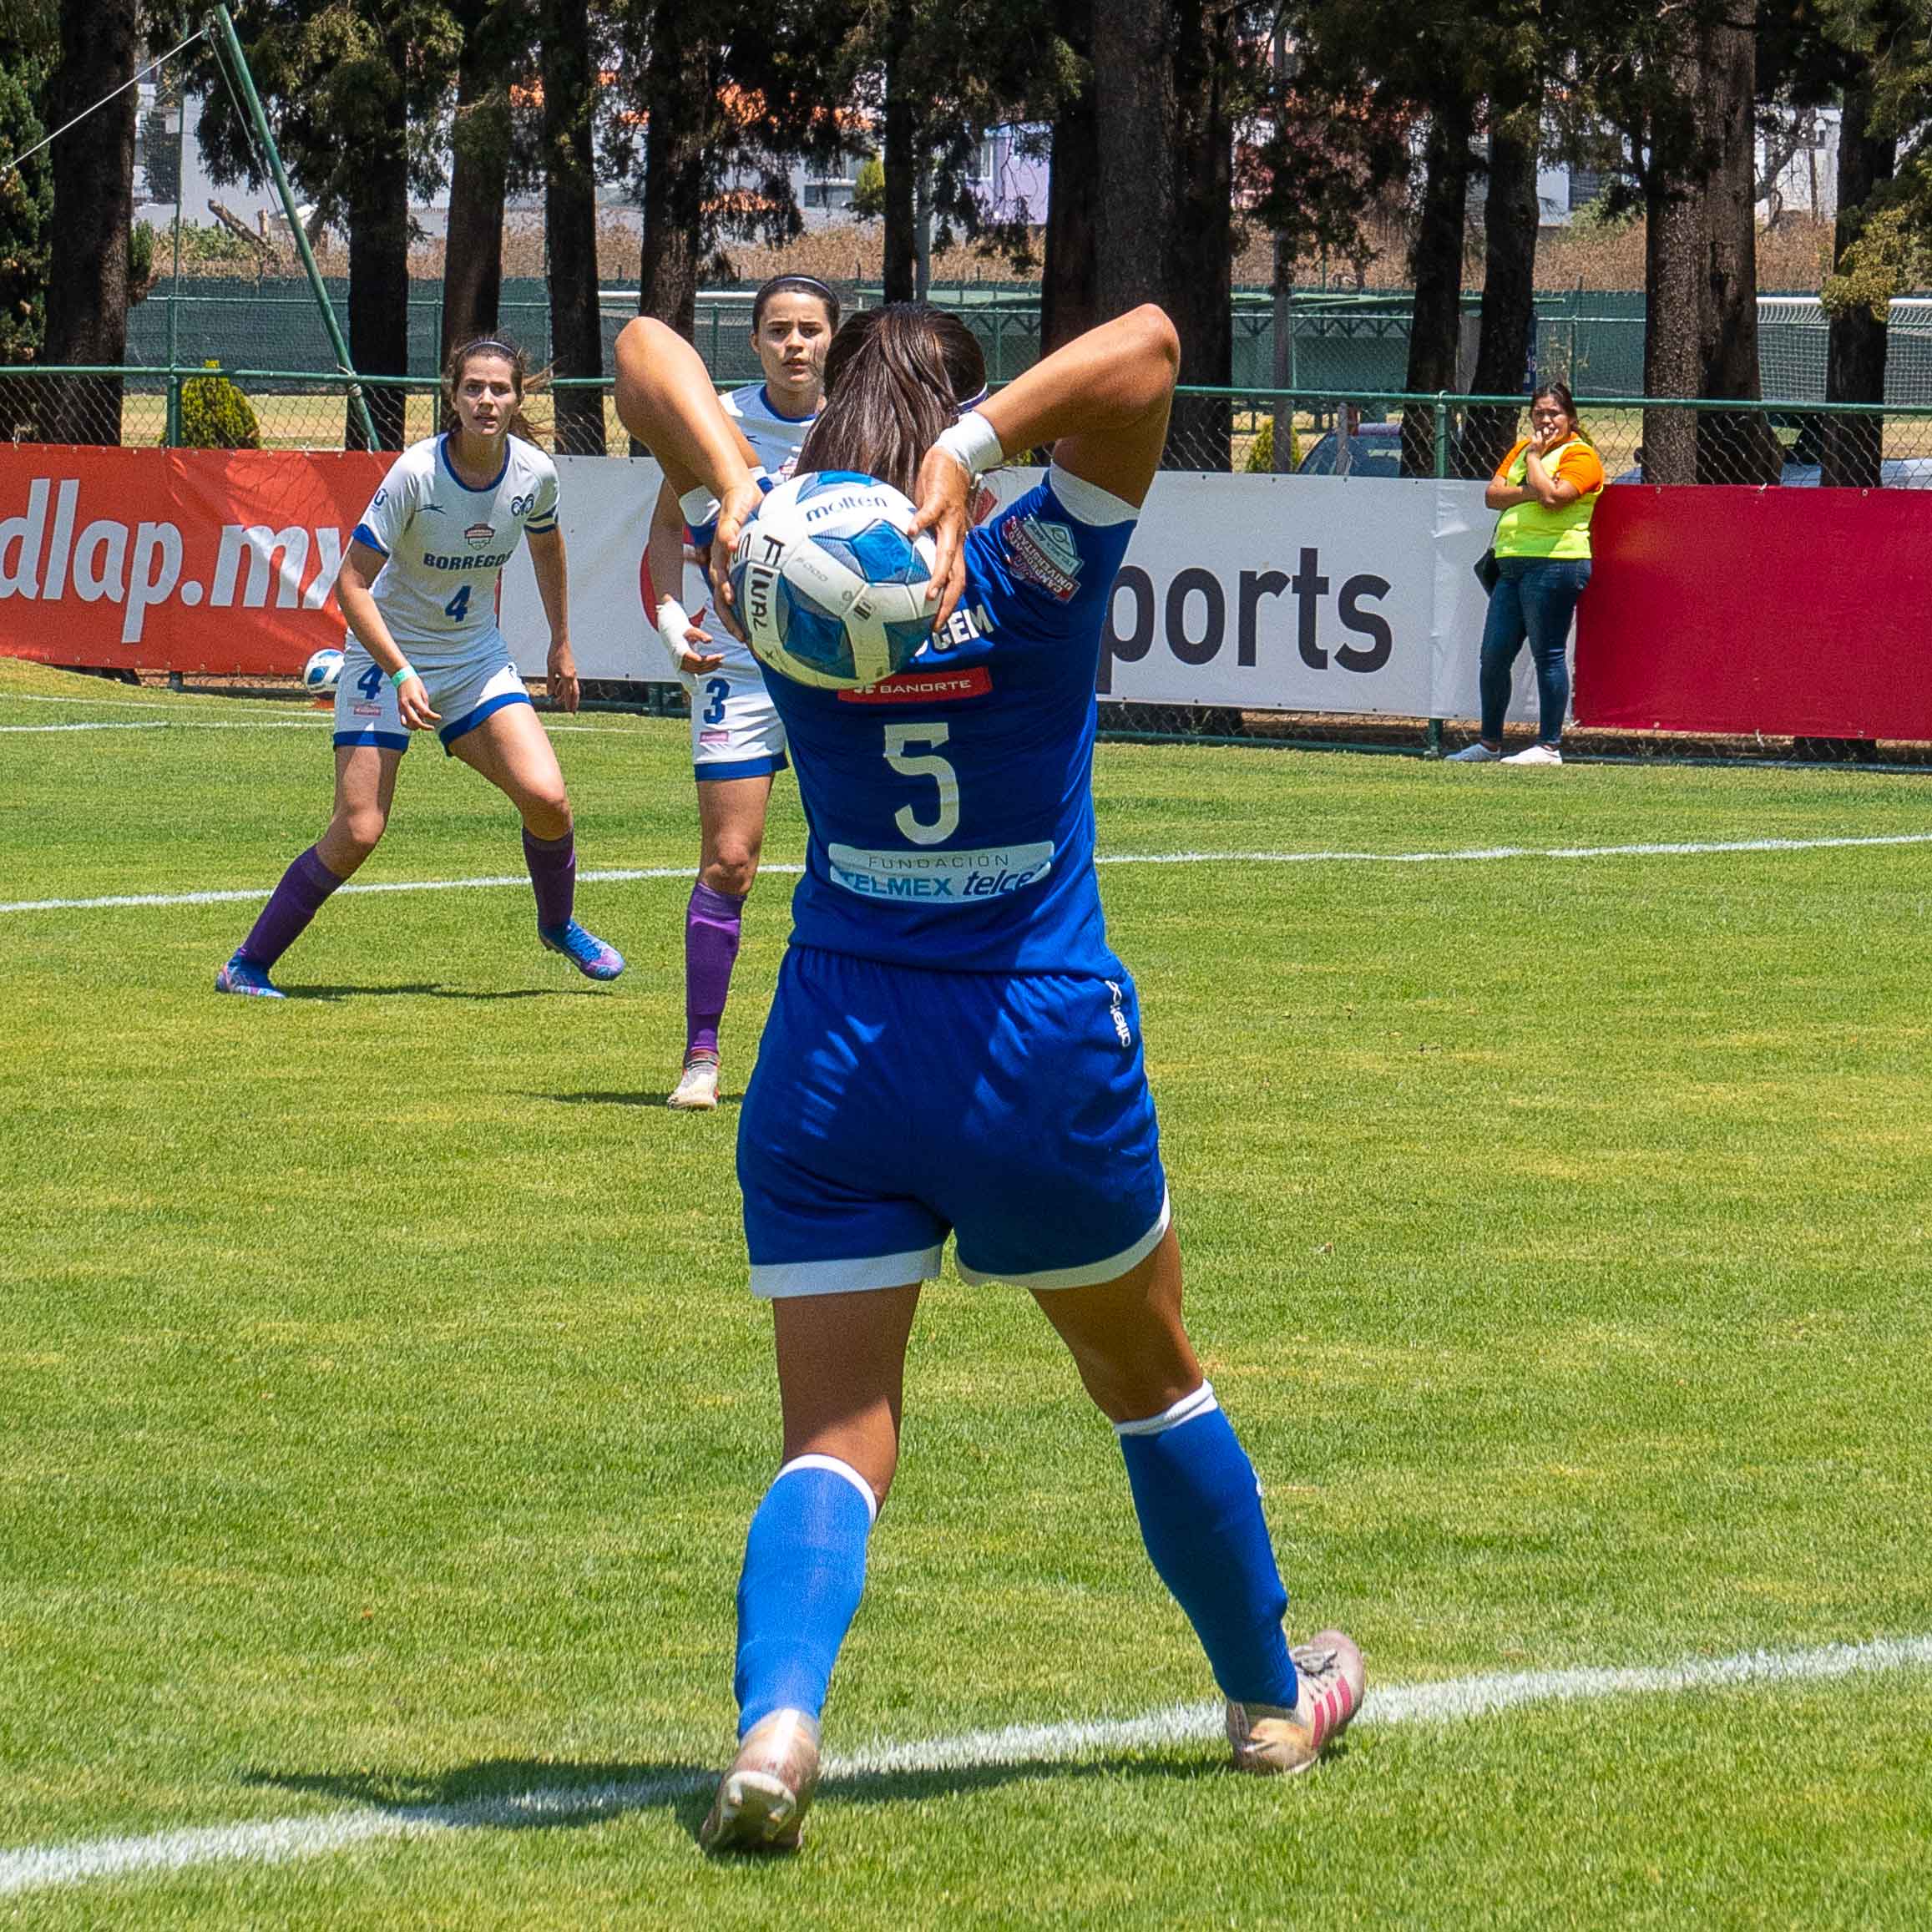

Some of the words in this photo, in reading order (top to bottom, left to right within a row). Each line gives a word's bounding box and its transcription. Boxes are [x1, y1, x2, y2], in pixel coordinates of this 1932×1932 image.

[807, 497, 888, 522] molten
[445, 585, 472, 623] 4
[1095, 547, 1393, 695] ports
[357, 662, 383, 700] 4
[880, 680, 972, 694] BANORTE
[703, 677, 731, 724] 3
[883, 723, 959, 845] 5
[963, 868, 1039, 895] telce
